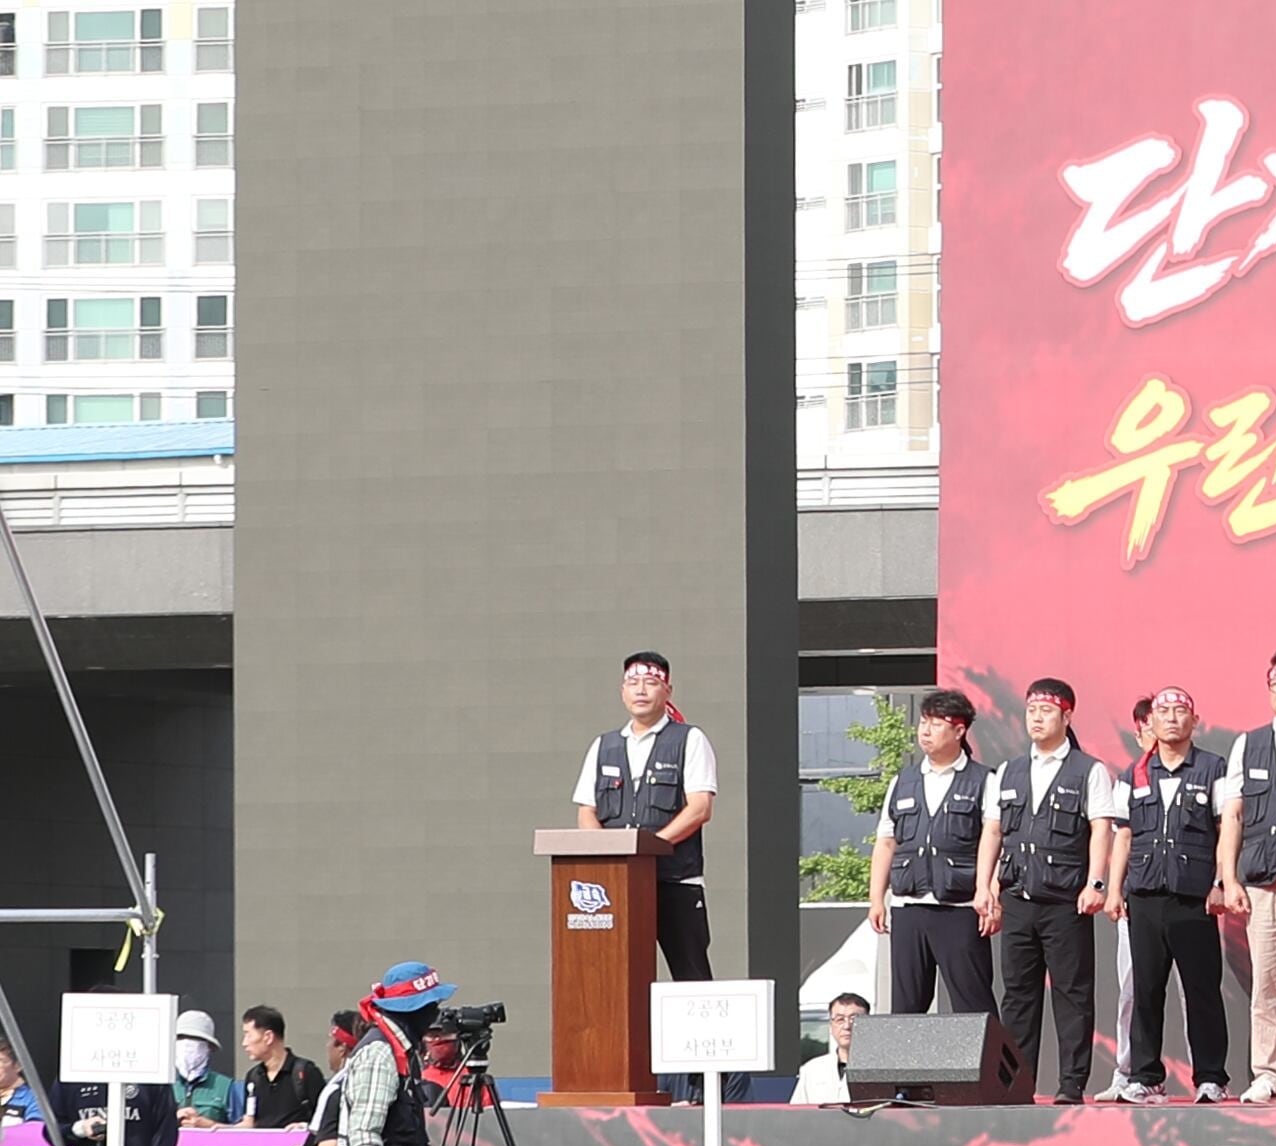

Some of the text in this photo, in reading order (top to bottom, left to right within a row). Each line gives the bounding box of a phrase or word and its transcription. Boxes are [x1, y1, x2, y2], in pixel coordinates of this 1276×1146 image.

[686, 999, 731, 1018] 2공장
[683, 1037, 736, 1057] 사업부
[91, 1047, 139, 1069] 사업부
[79, 1106, 140, 1122] VENIA
